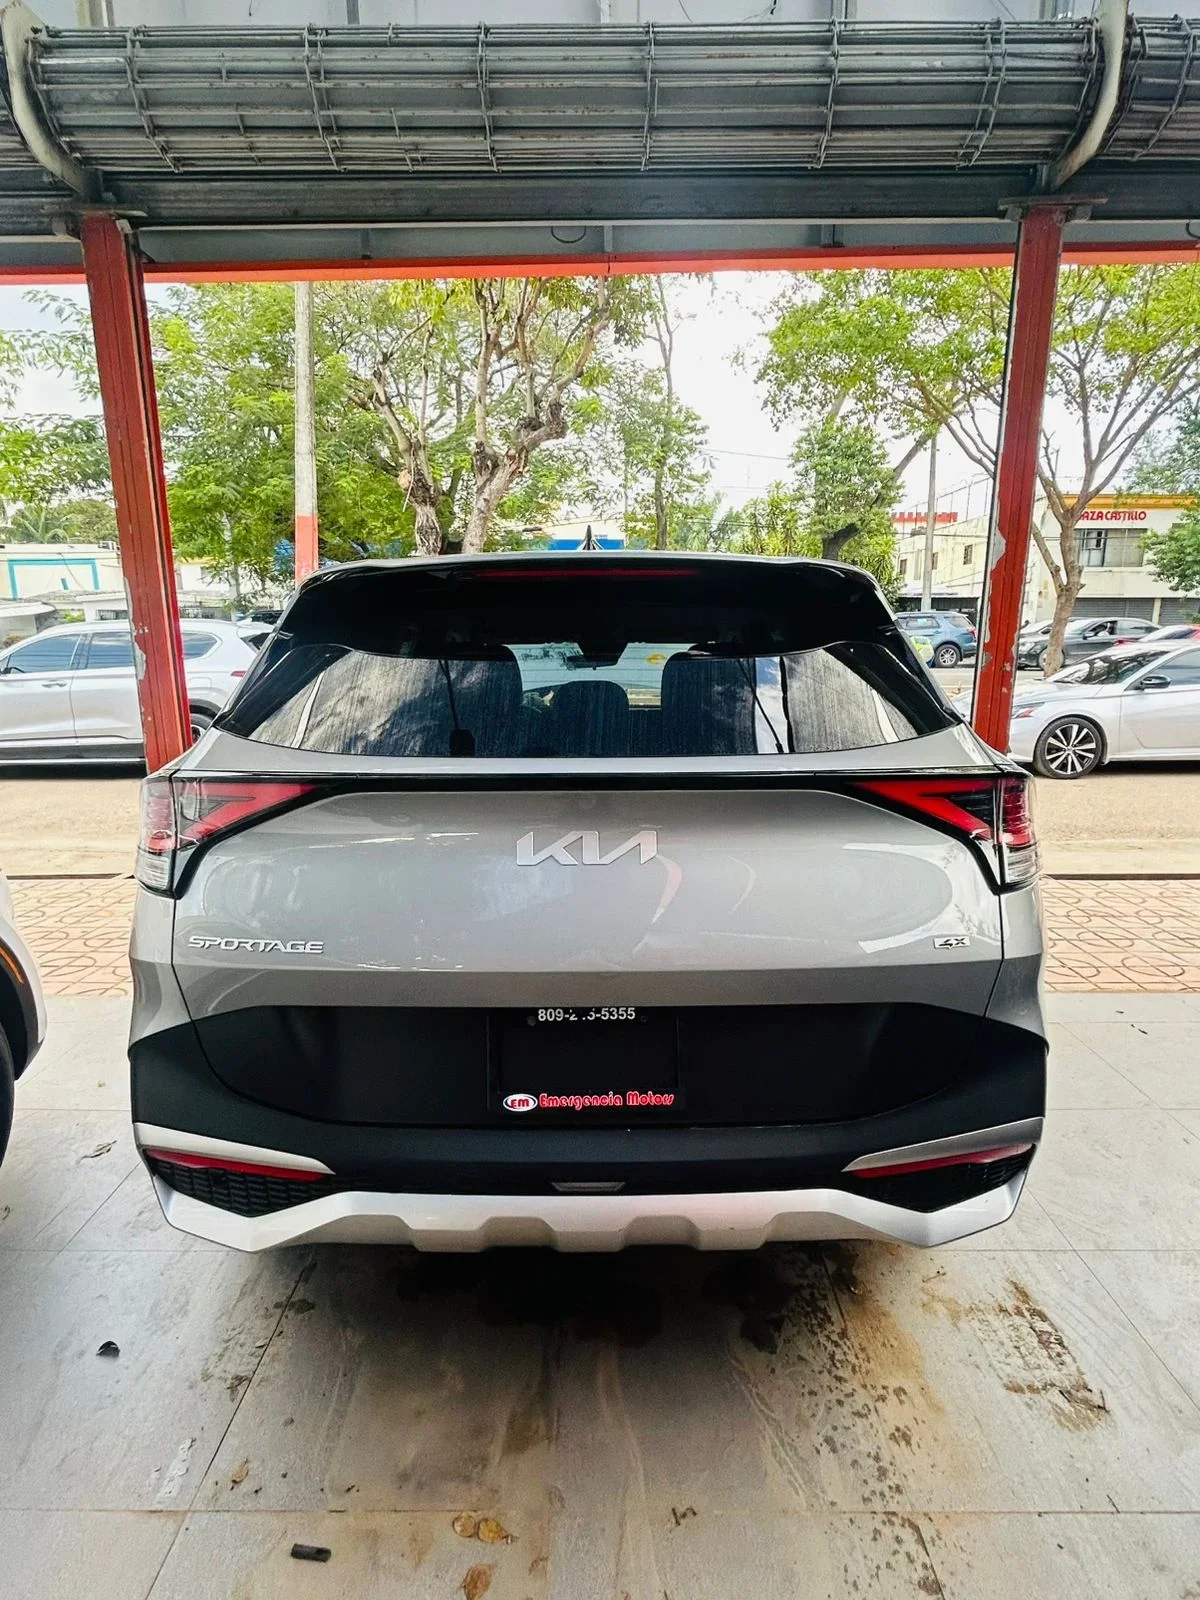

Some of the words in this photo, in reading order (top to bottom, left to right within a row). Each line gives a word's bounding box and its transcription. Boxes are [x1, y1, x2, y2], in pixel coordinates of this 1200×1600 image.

[1080, 511, 1104, 521] AZA
[1105, 511, 1147, 521] CASTILLO
[516, 830, 658, 866] KIA
[188, 935, 324, 954] SPORTAGE
[537, 1007, 636, 1021] 809-25-5355
[539, 1091, 623, 1110] Emergencia
[626, 1091, 675, 1105] Motors
